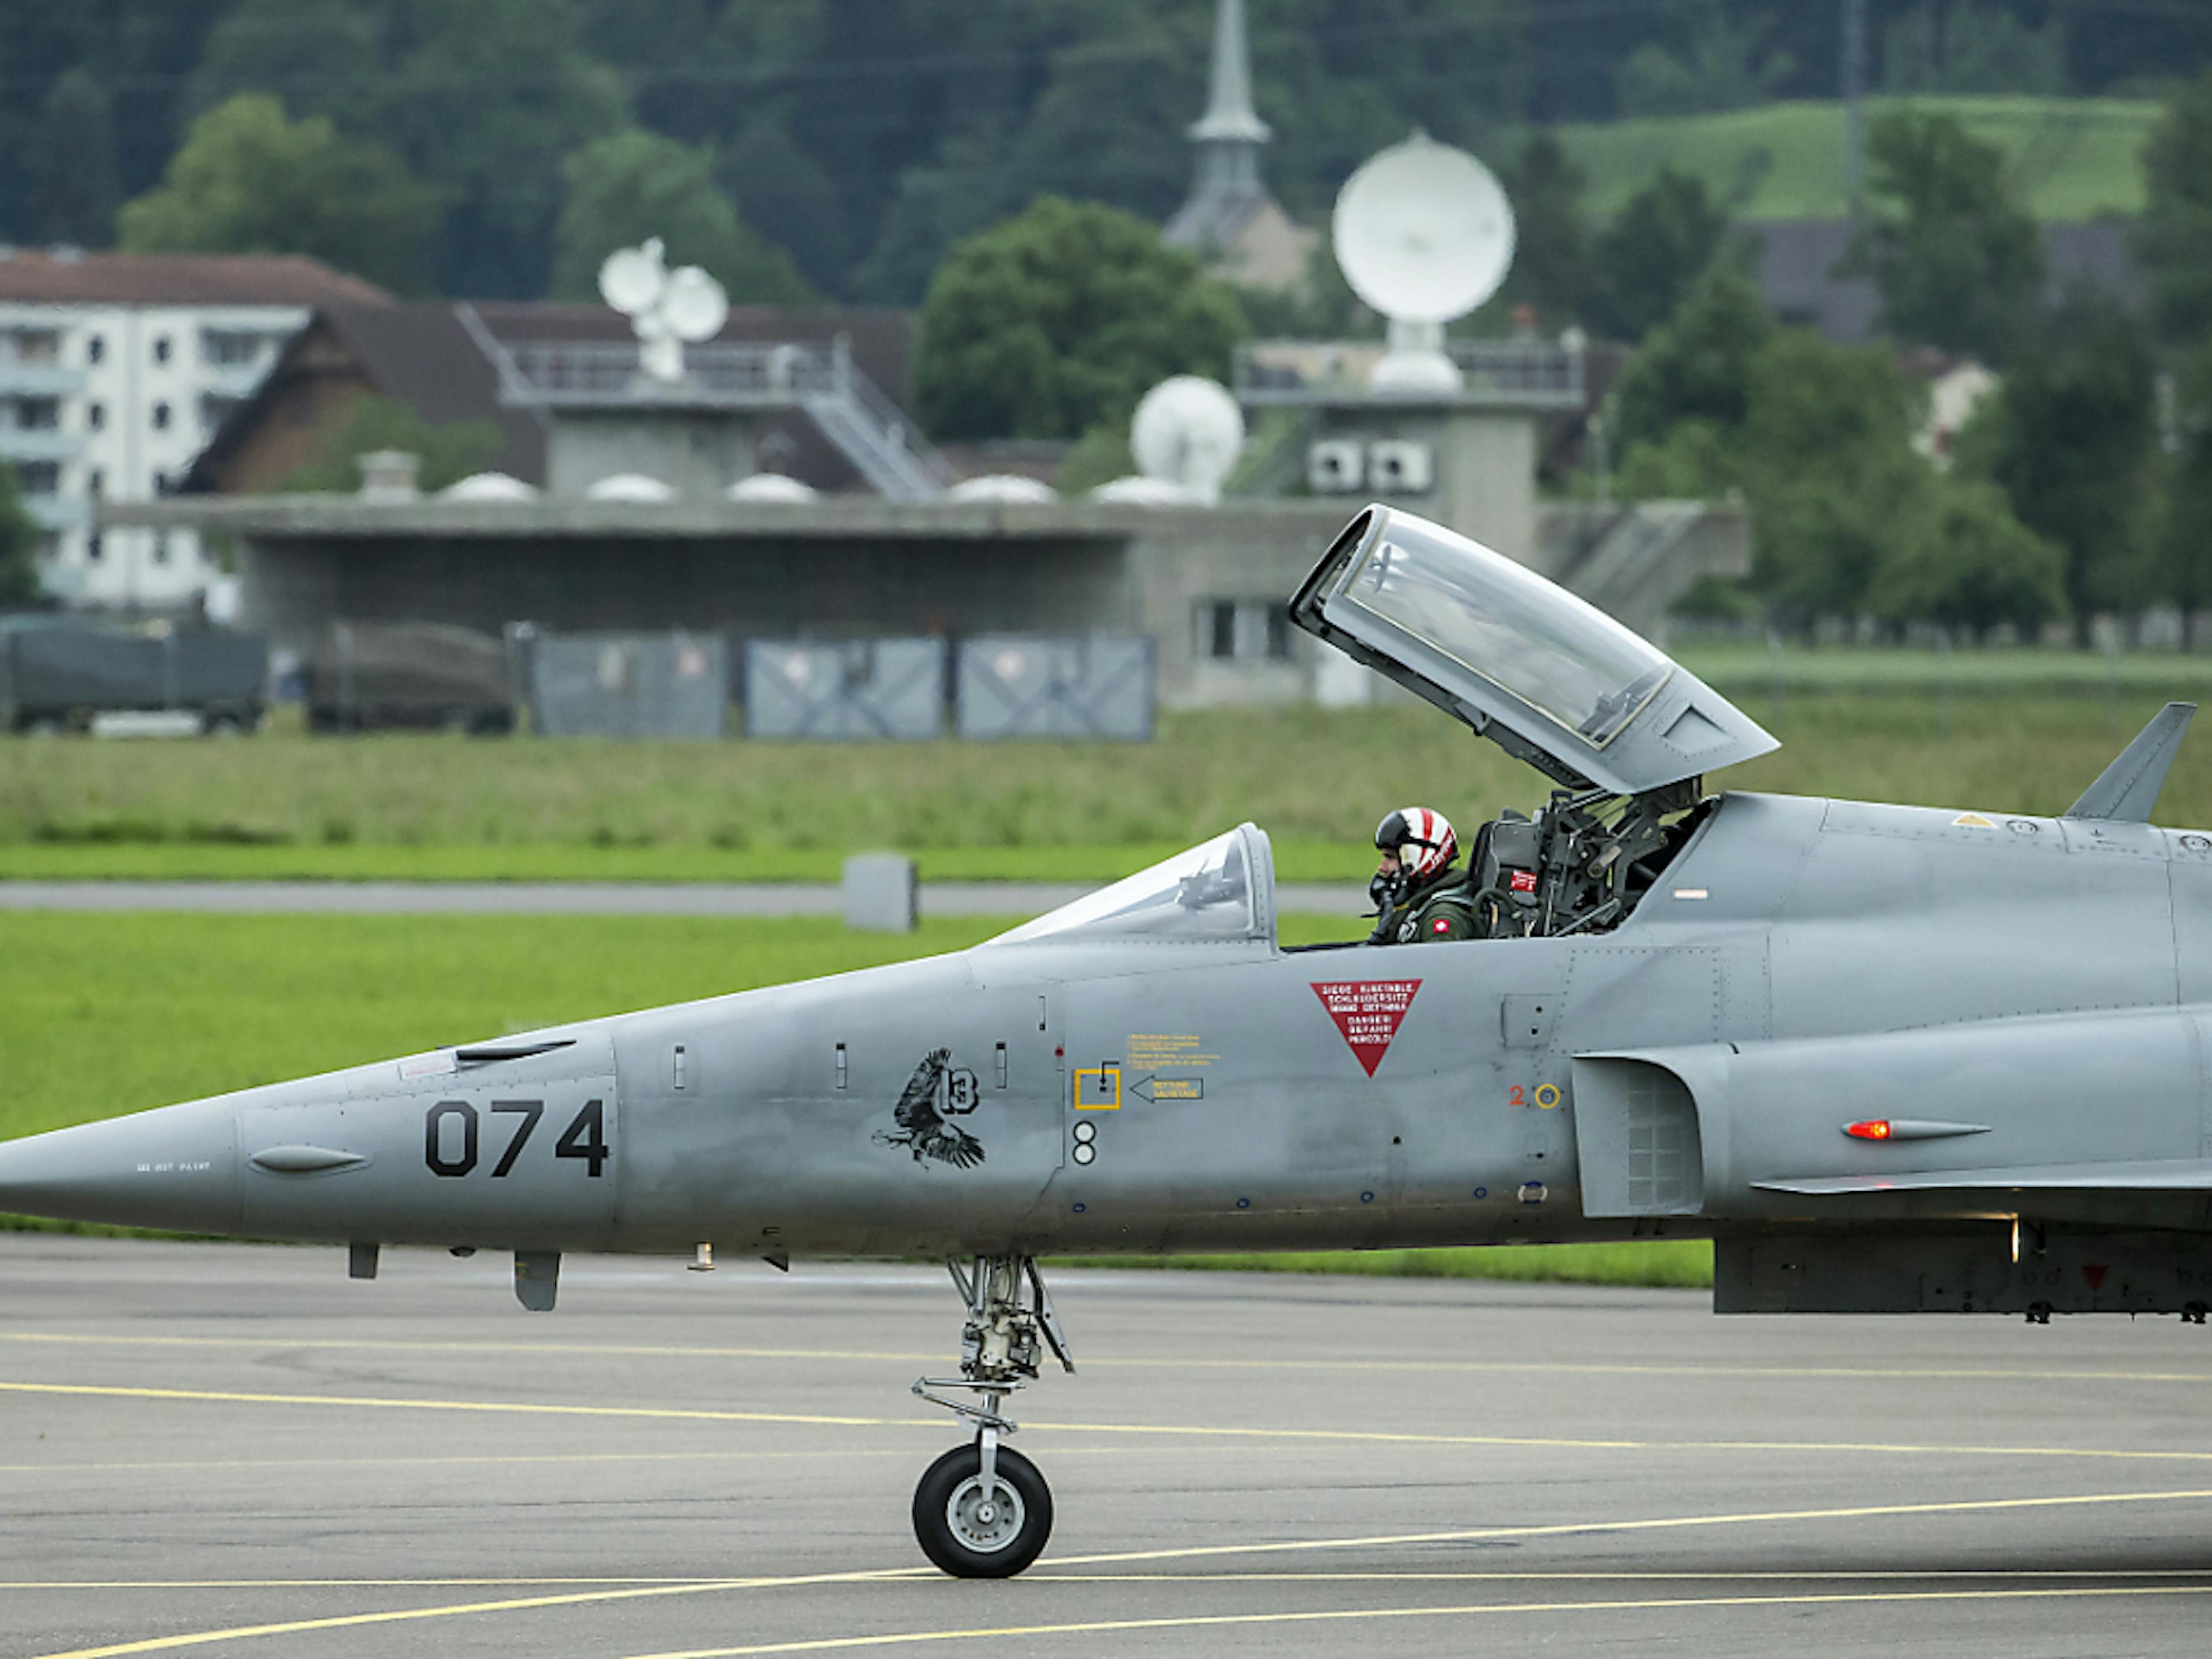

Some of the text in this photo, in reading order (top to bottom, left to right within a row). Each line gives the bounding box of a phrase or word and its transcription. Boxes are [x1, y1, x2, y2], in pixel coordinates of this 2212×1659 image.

[940, 1068, 979, 1115] 13
[1509, 1085, 1525, 1106] 2
[425, 1100, 609, 1177] 074
